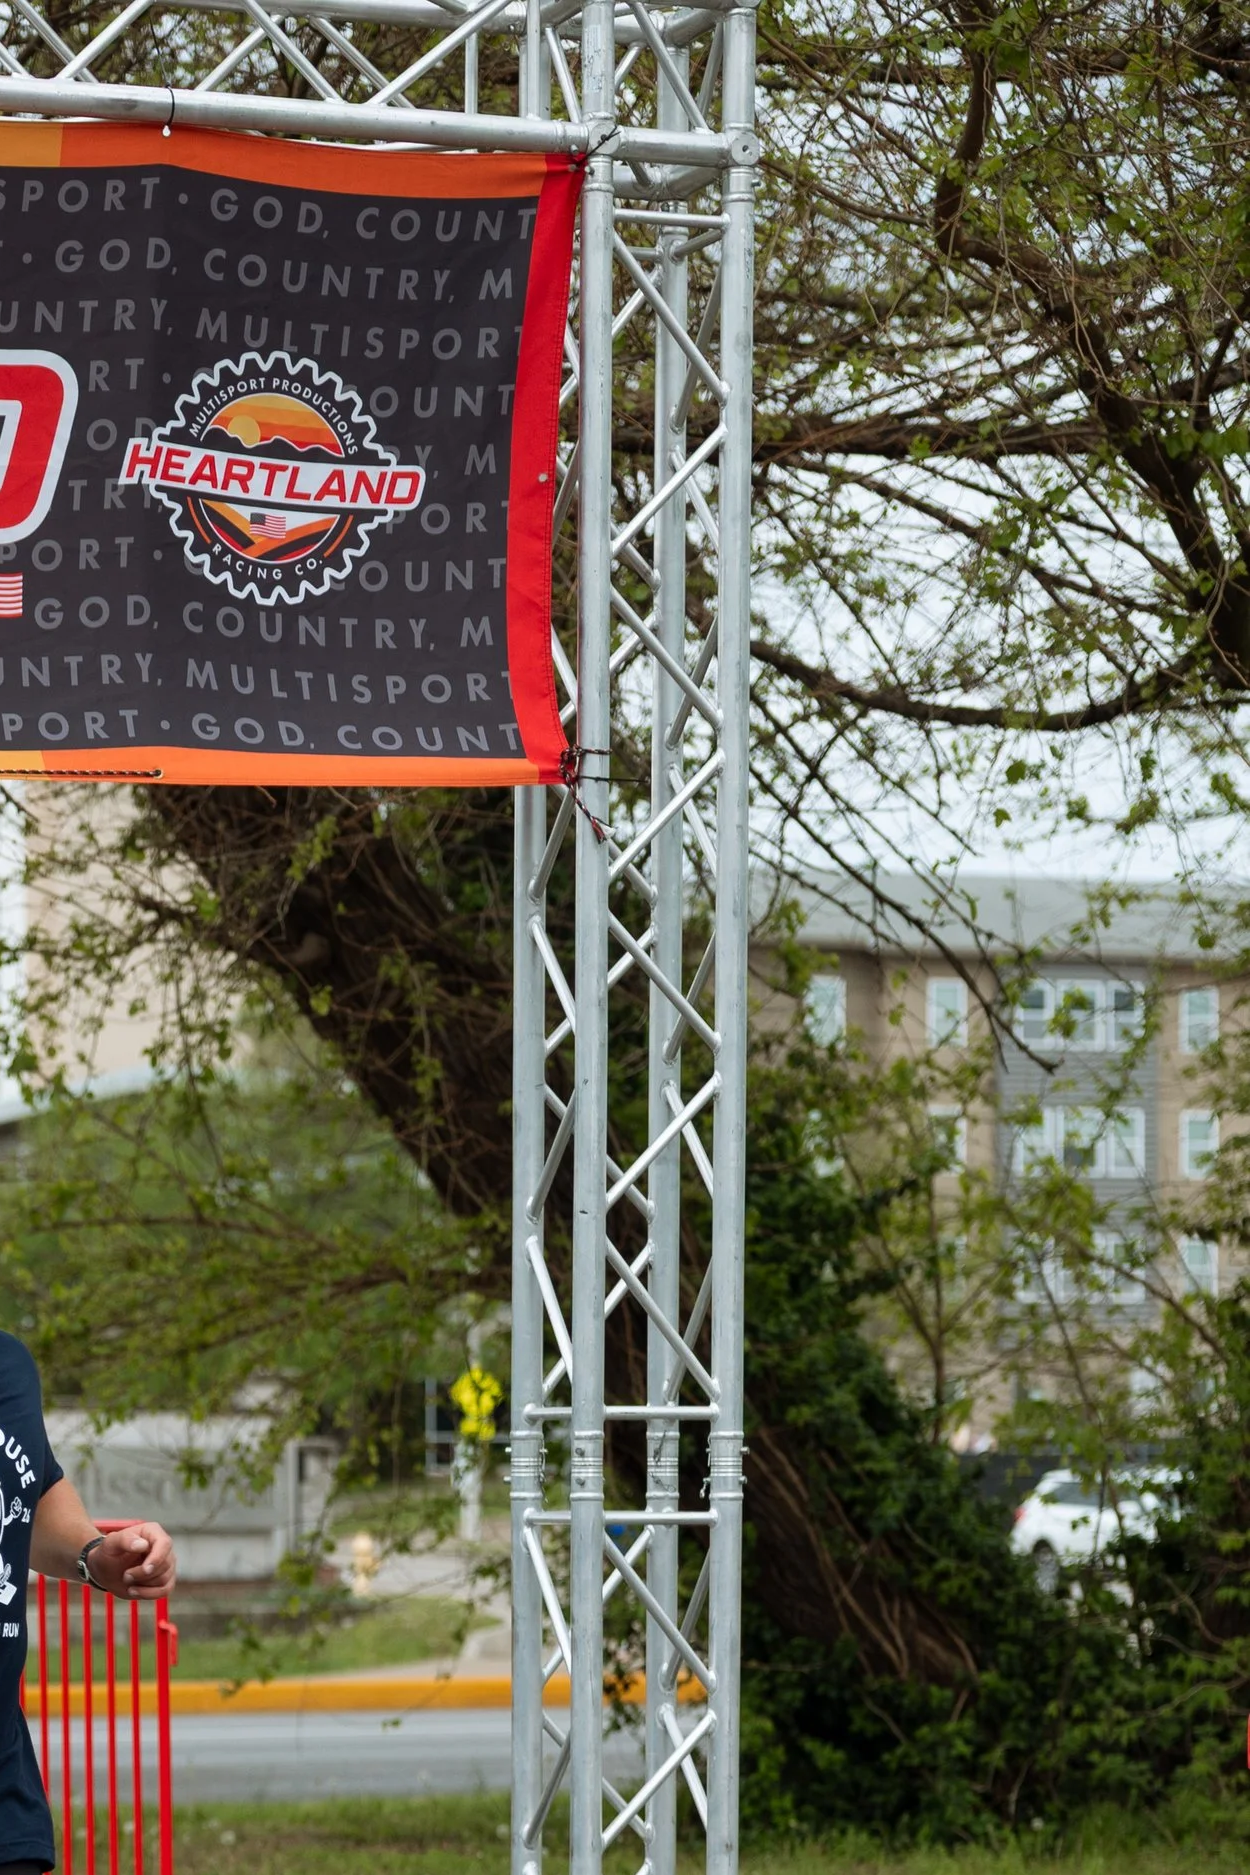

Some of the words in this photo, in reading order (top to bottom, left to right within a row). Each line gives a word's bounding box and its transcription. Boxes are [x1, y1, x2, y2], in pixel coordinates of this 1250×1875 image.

[210, 188, 329, 239] GOD,
[54, 236, 178, 276] GOD,
[203, 247, 455, 304] COUNTRY,
[190, 377, 266, 438] MULTISPORT
[272, 377, 359, 456] PRODUCTIONS
[341, 383, 516, 419] OUNT
[124, 442, 422, 507] HEARTLAND
[212, 543, 282, 580] RACING
[295, 557, 324, 576] CO.
[34, 596, 158, 630] GOD,
[182, 604, 436, 651] COUNTRY,
[191, 712, 315, 750] GOD,
[2, 1622, 20, 1638] RUN
